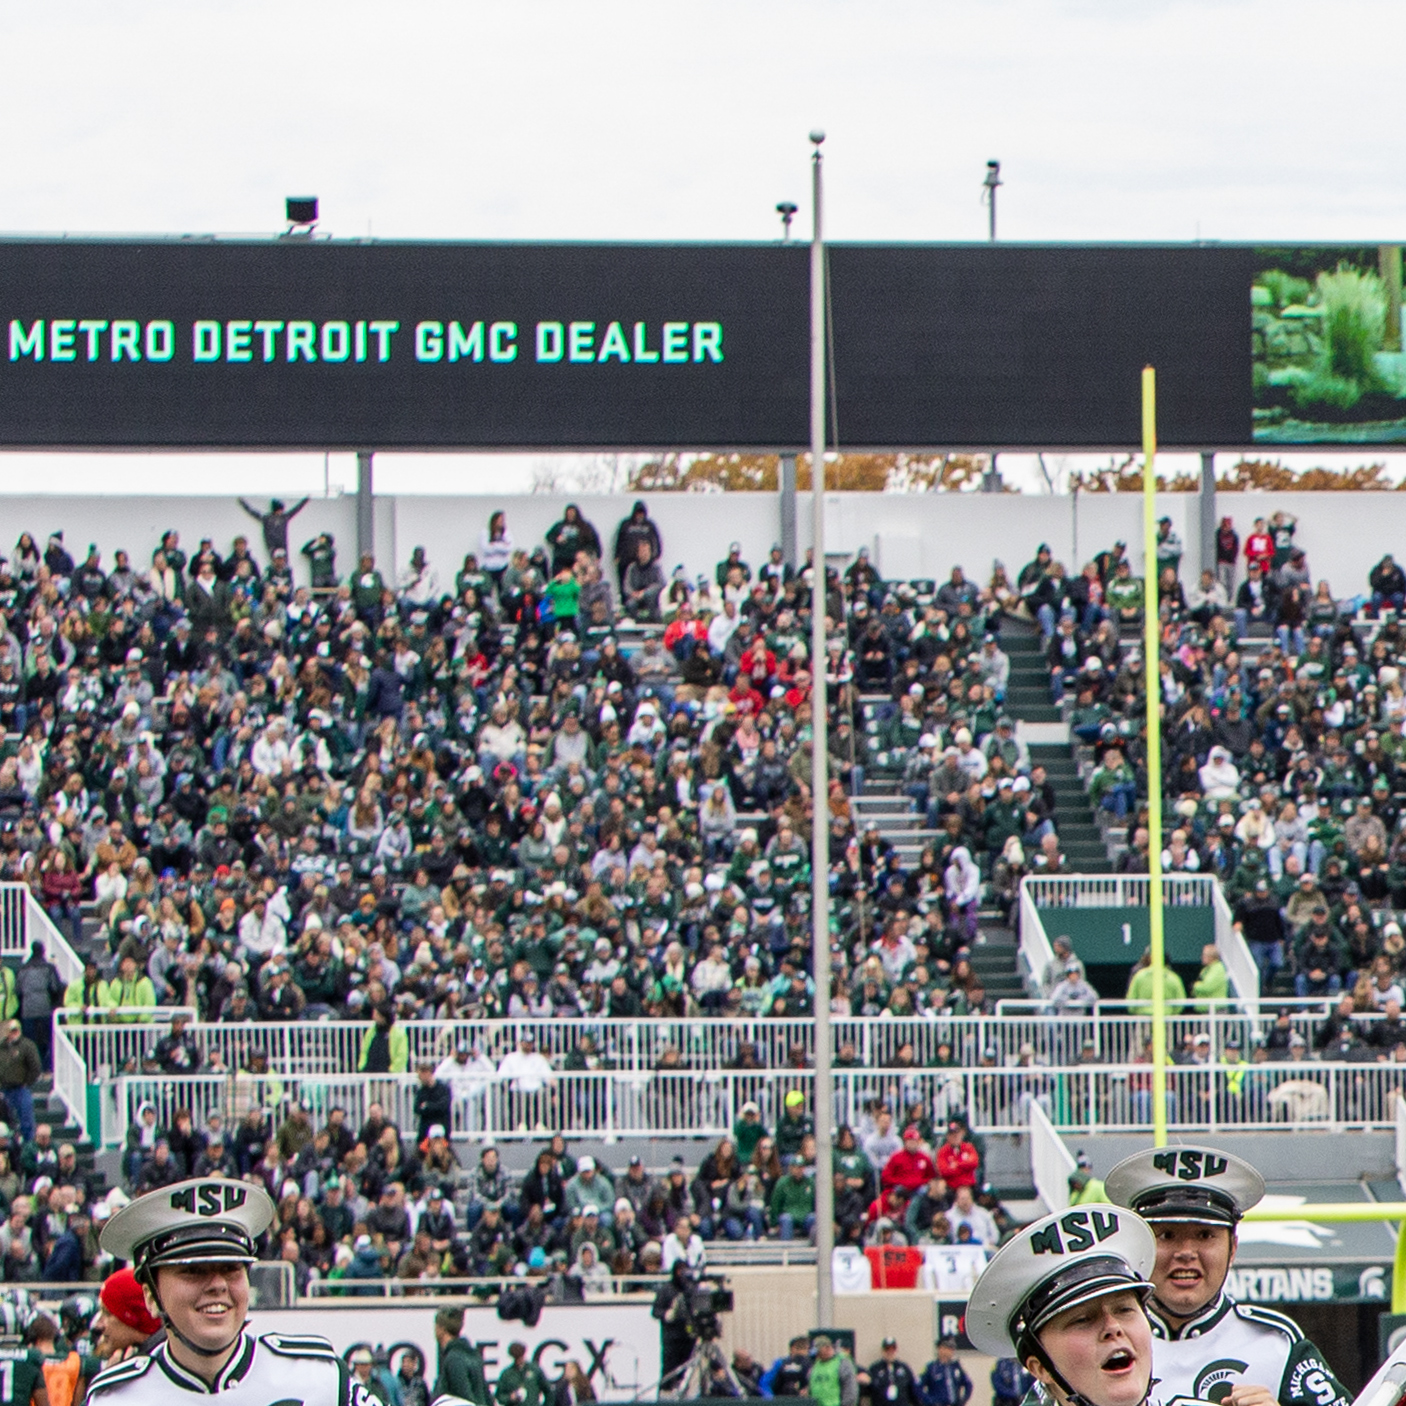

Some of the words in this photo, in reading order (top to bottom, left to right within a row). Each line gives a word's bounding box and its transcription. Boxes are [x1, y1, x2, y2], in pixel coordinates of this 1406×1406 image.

[9, 319, 175, 363] METRO
[193, 319, 400, 363] DETROIT
[414, 320, 518, 363] GMC
[535, 321, 725, 364] DEALER
[1153, 1150, 1229, 1181] MSU
[170, 1184, 248, 1217] MSU
[1030, 1211, 1120, 1255] MSU
[1221, 1267, 1334, 1301] ARTANS
[1305, 1371, 1336, 1406] S
